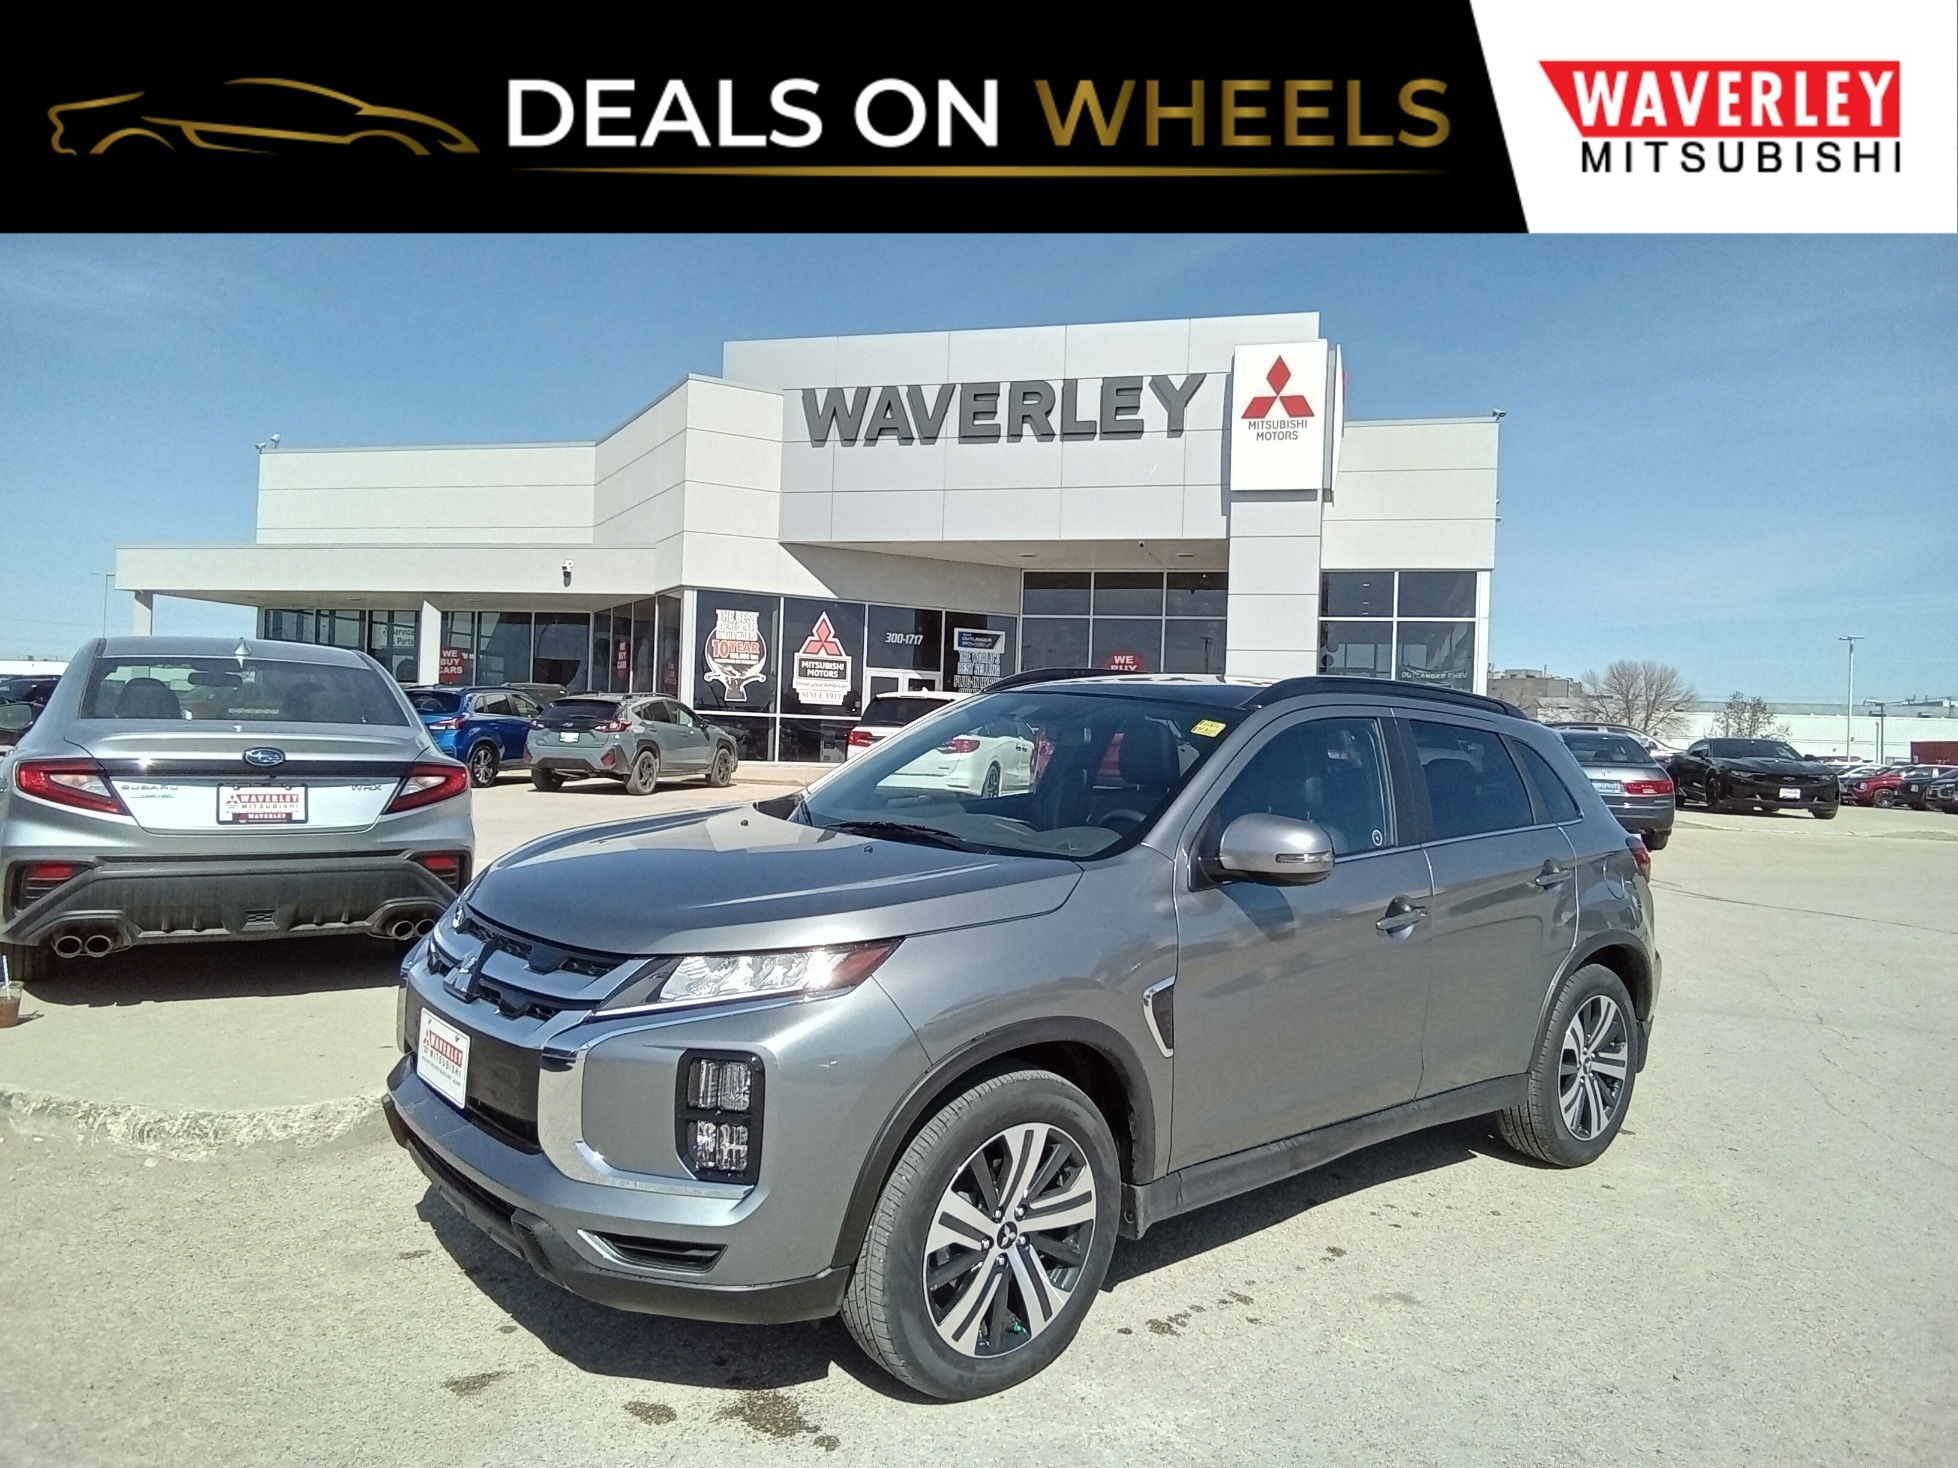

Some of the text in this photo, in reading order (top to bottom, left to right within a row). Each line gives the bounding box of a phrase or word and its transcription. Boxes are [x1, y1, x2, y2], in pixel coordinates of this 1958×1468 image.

[802, 373, 1206, 447] WAVERLEY
[1248, 419, 1308, 430] MITSUBISHI
[1256, 430, 1299, 441] MOTORS
[716, 609, 760, 622] THE BEST
[885, 632, 924, 646] 300-1717
[442, 650, 459, 658] WE
[712, 640, 729, 658] 10
[729, 641, 760, 653] YEAR
[440, 658, 460, 666] BUY
[1114, 655, 1134, 664] WE
[801, 661, 845, 670] MITSUBISHI
[957, 662, 1001, 677] BEST SELLING
[807, 669, 839, 678] MOTORS
[801, 691, 842, 700] SINCE 1917
[240, 794, 298, 803] WAVERLEY
[430, 1031, 463, 1067] WAVERLEY
[429, 1049, 462, 1079] MITSUBISHI
